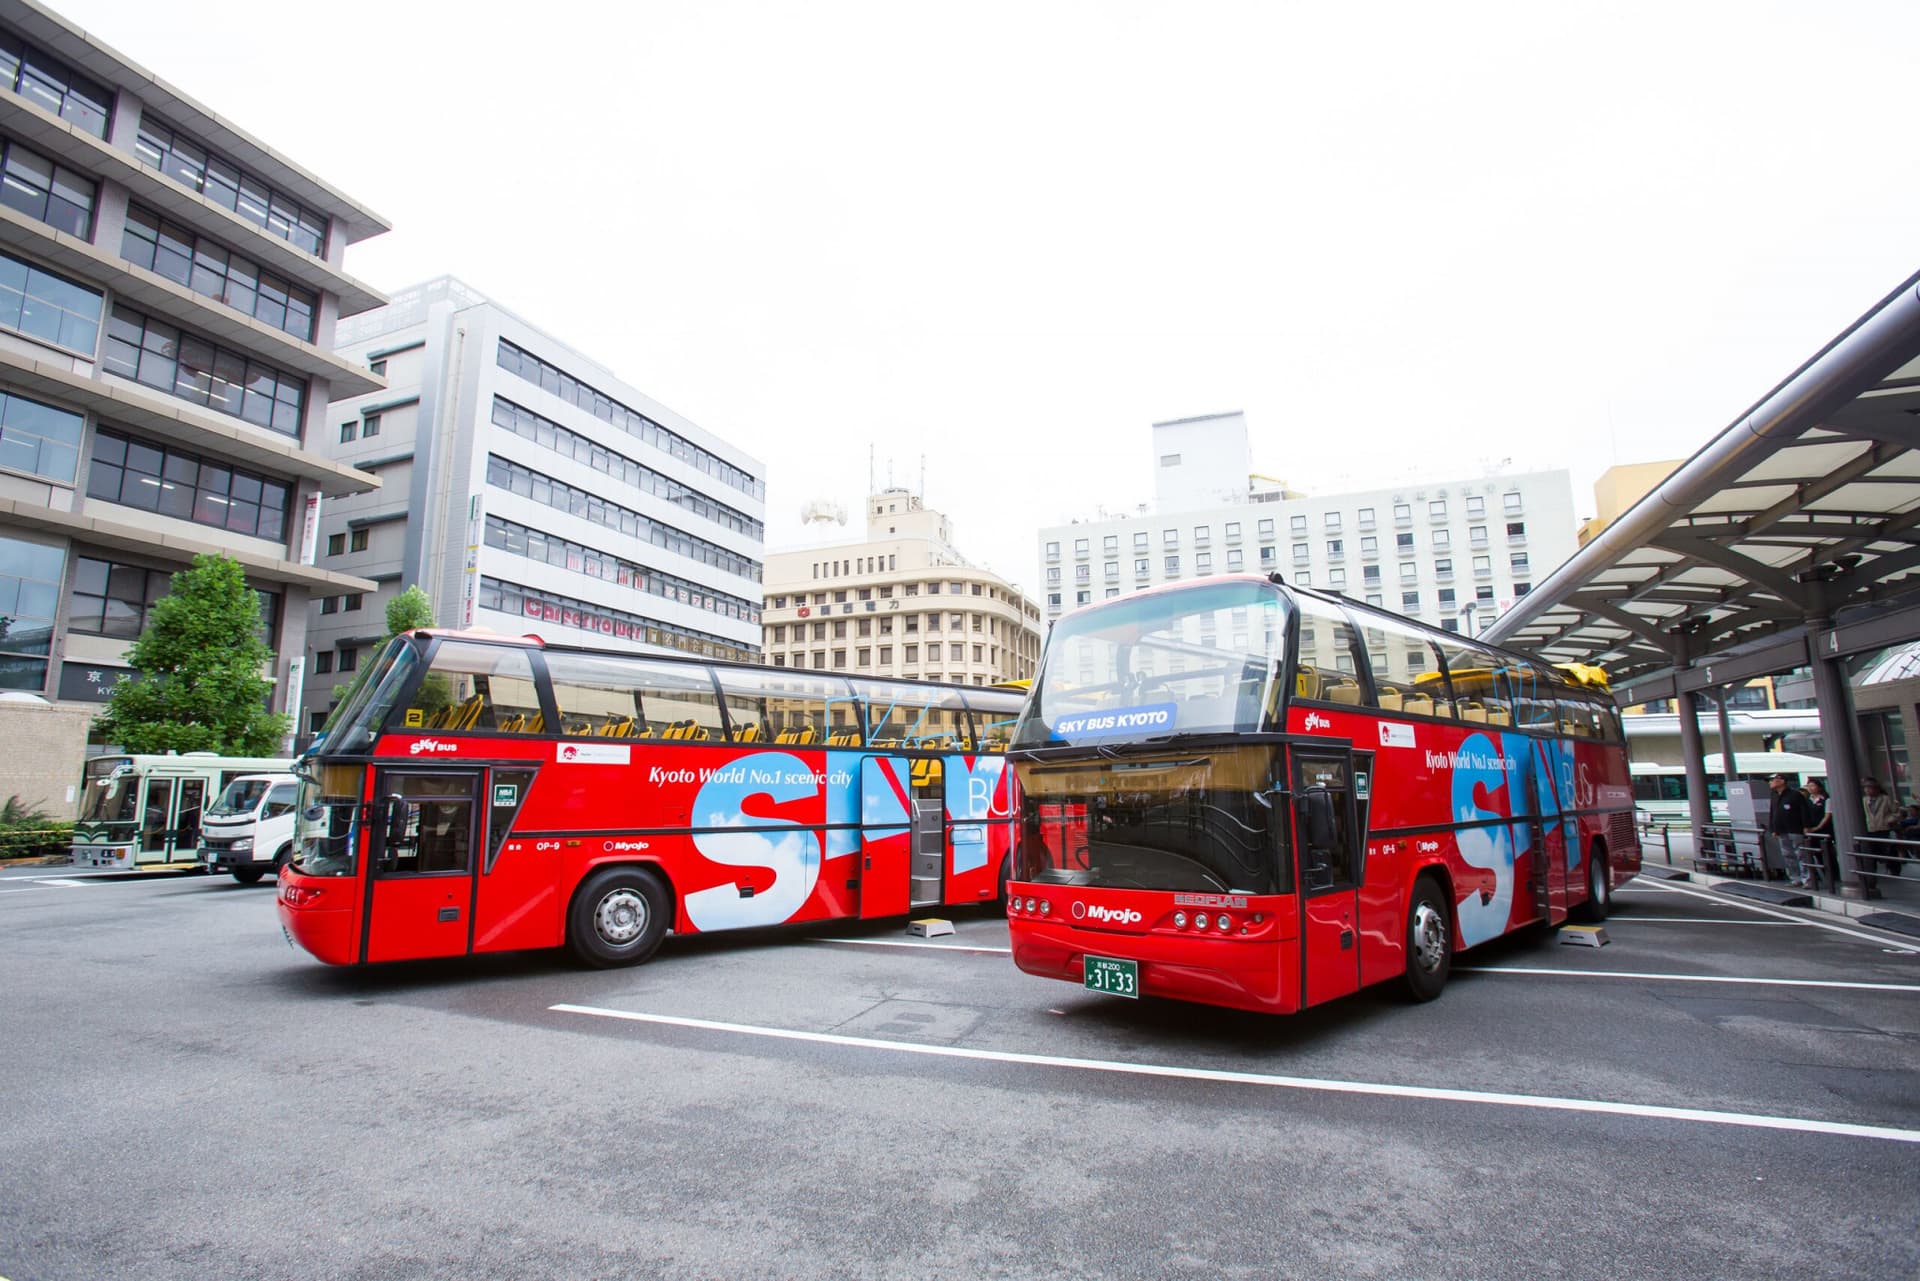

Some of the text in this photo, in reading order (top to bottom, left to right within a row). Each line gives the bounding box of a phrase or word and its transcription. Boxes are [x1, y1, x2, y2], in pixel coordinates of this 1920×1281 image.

[1829, 631, 1839, 652] 4
[408, 713, 421, 723] 2
[1057, 710, 1168, 734] SKY BUS KYOTO
[410, 738, 438, 754] SKY
[1425, 749, 1449, 774] Kyoto
[1448, 751, 1470, 769] World
[1487, 752, 1506, 770] scenic
[648, 766, 854, 789] Kyoto World No.1 scenic city
[1562, 762, 1593, 805] BUS
[969, 777, 1020, 817] BU
[614, 841, 649, 851] Myojo
[1087, 905, 1142, 924] Myojo
